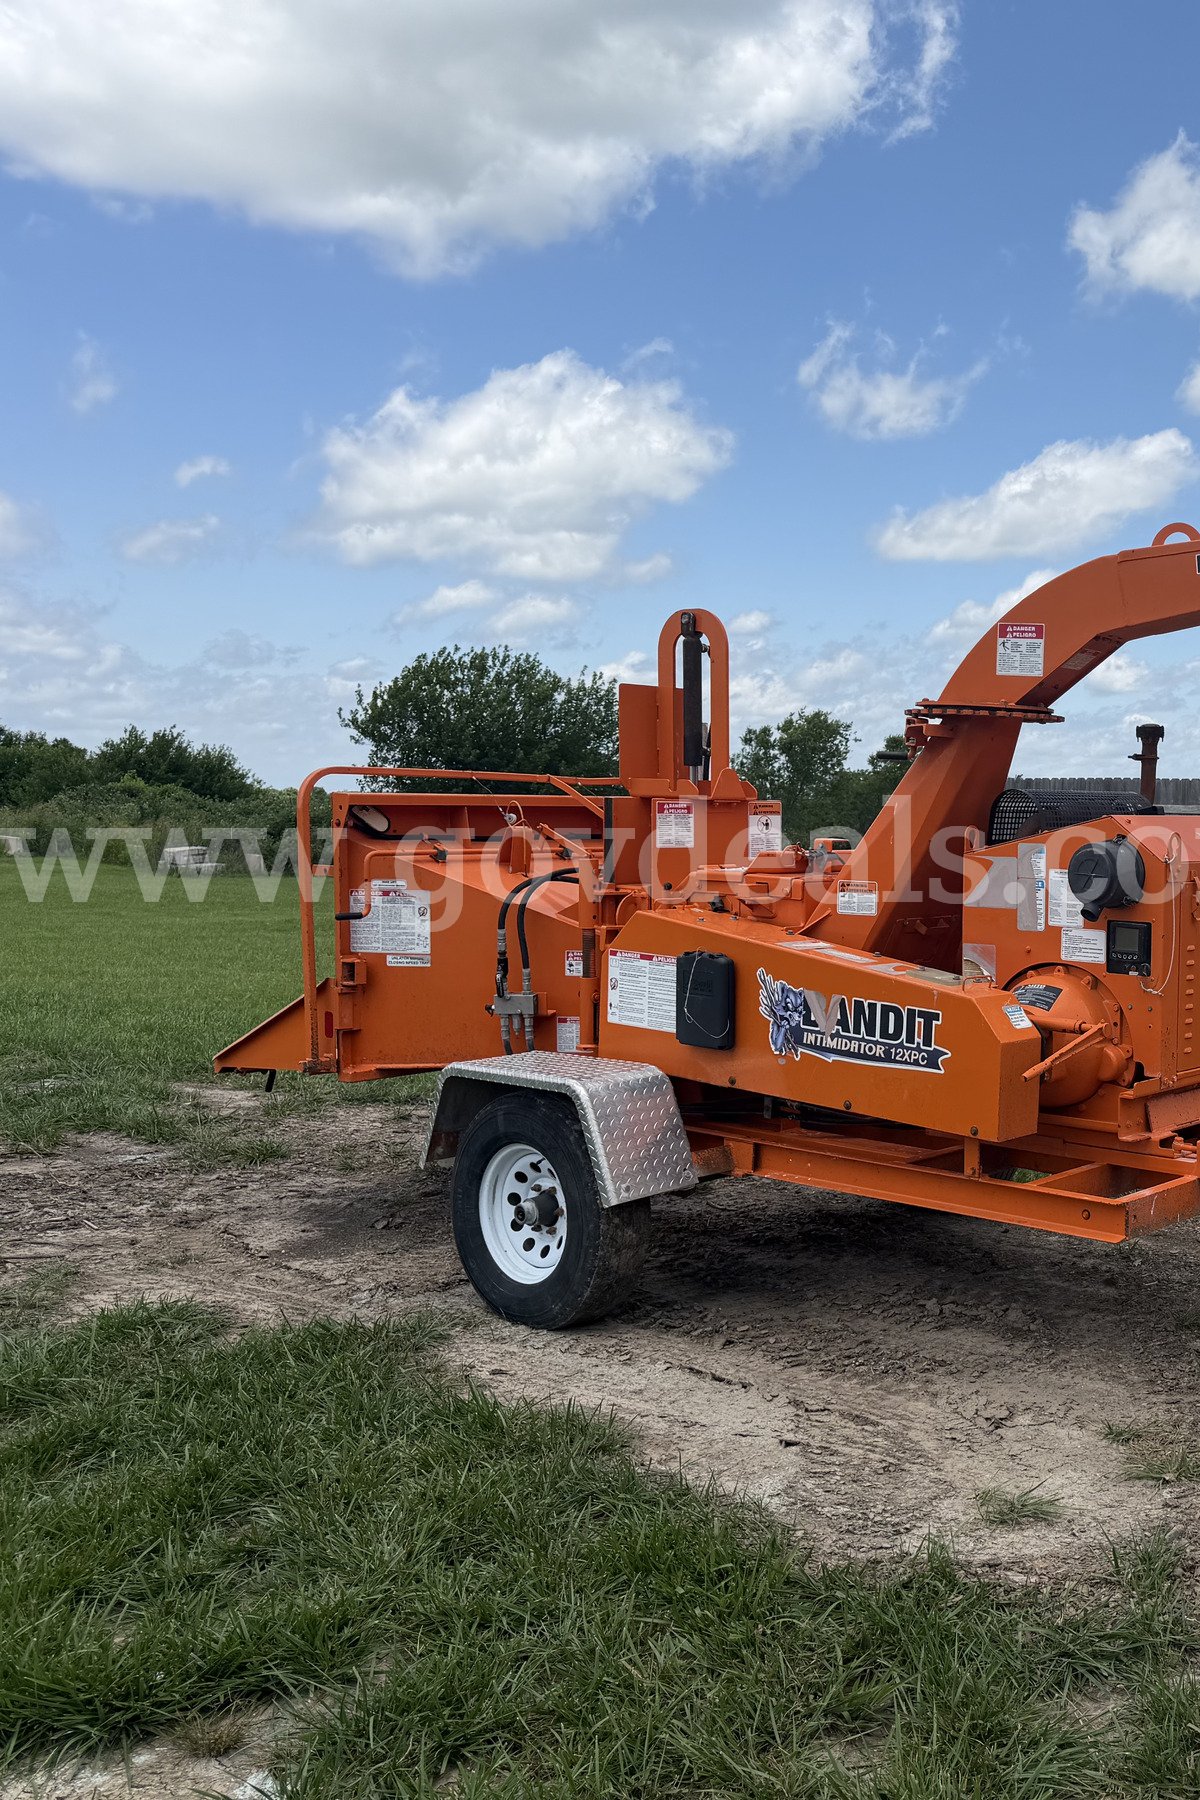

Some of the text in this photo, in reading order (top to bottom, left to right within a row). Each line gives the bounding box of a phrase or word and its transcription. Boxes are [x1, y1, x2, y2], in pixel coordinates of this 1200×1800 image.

[658, 956, 677, 964] PELIGR
[803, 1031, 928, 1065] INTIMIDATOR 12XPC
